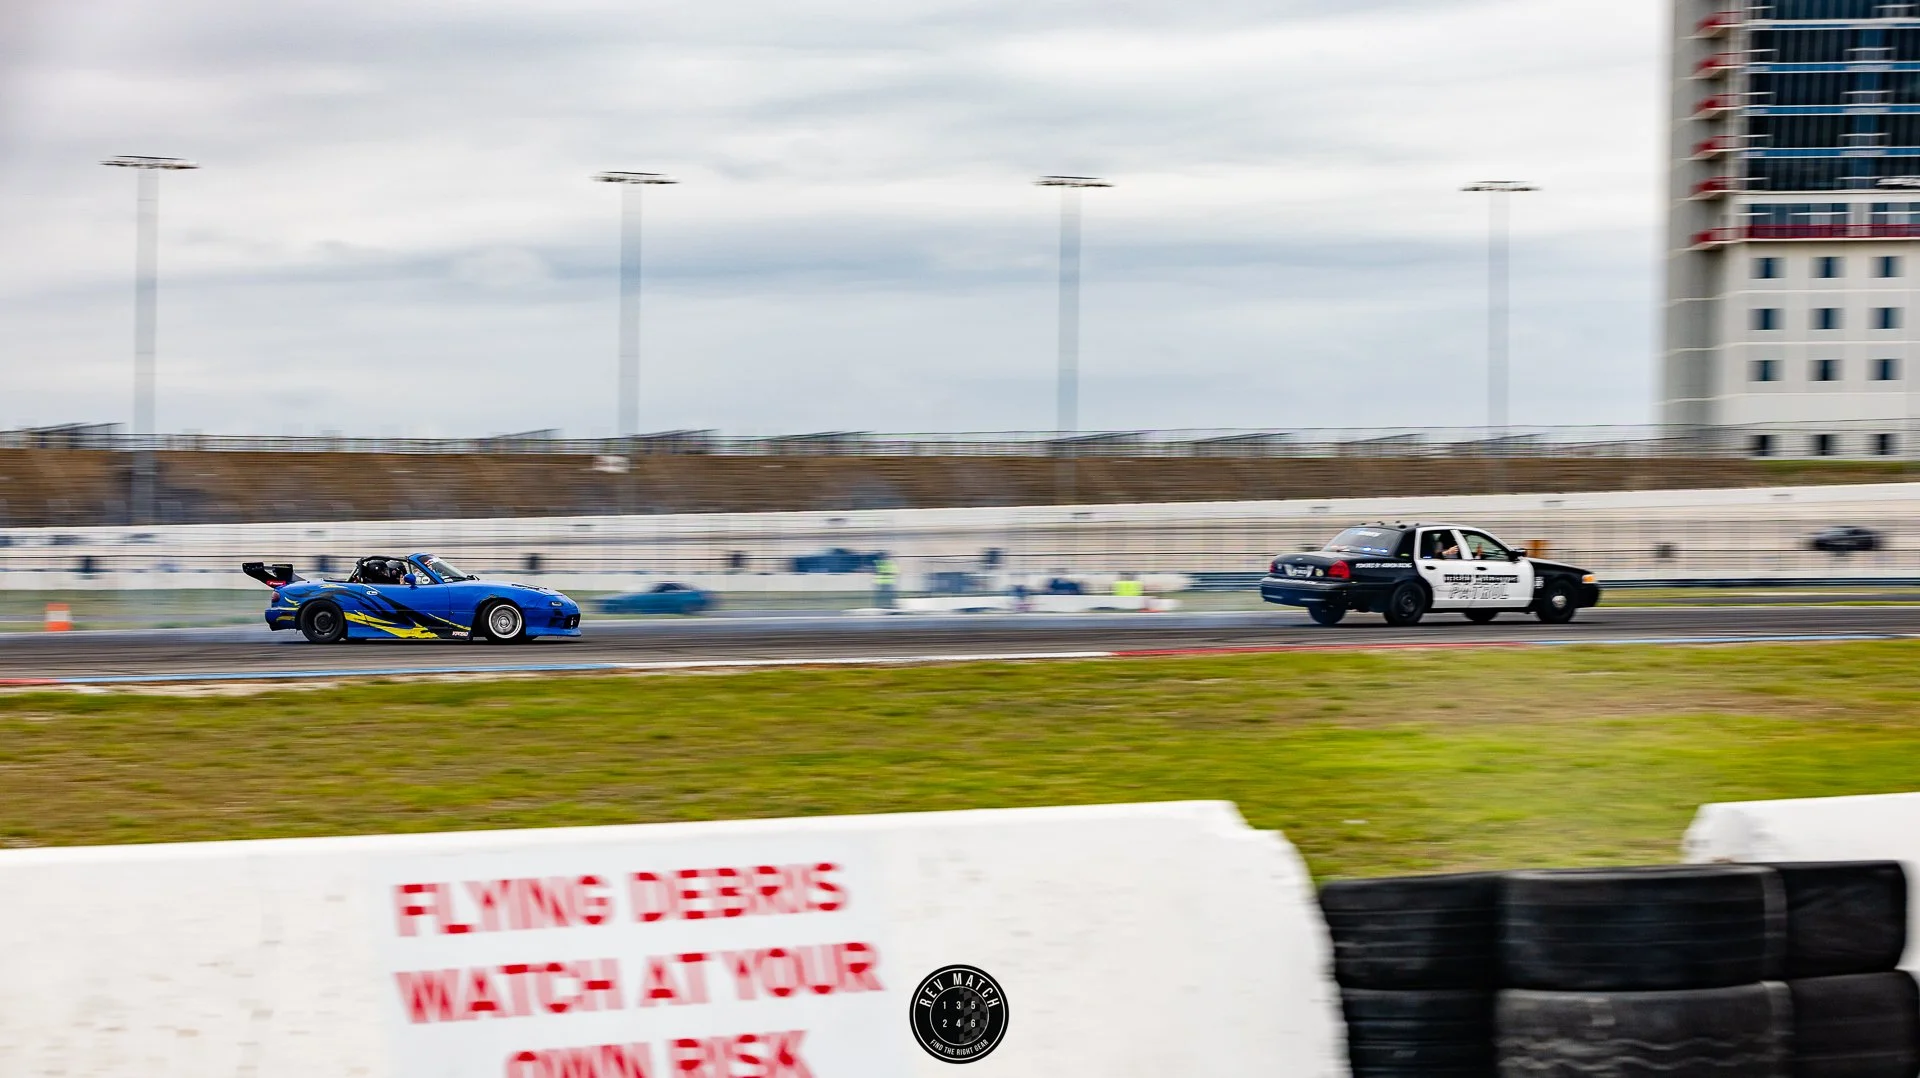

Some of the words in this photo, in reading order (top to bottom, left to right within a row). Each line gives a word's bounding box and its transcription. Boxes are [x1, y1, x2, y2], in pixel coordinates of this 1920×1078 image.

[1447, 583, 1509, 599] PATROL
[393, 874, 613, 936] FLYING
[628, 862, 846, 923] DEBRIS
[394, 958, 624, 1024] WATCH
[638, 952, 712, 1008] AT
[722, 941, 885, 1001] YOUR
[667, 1030, 816, 1078] RISK
